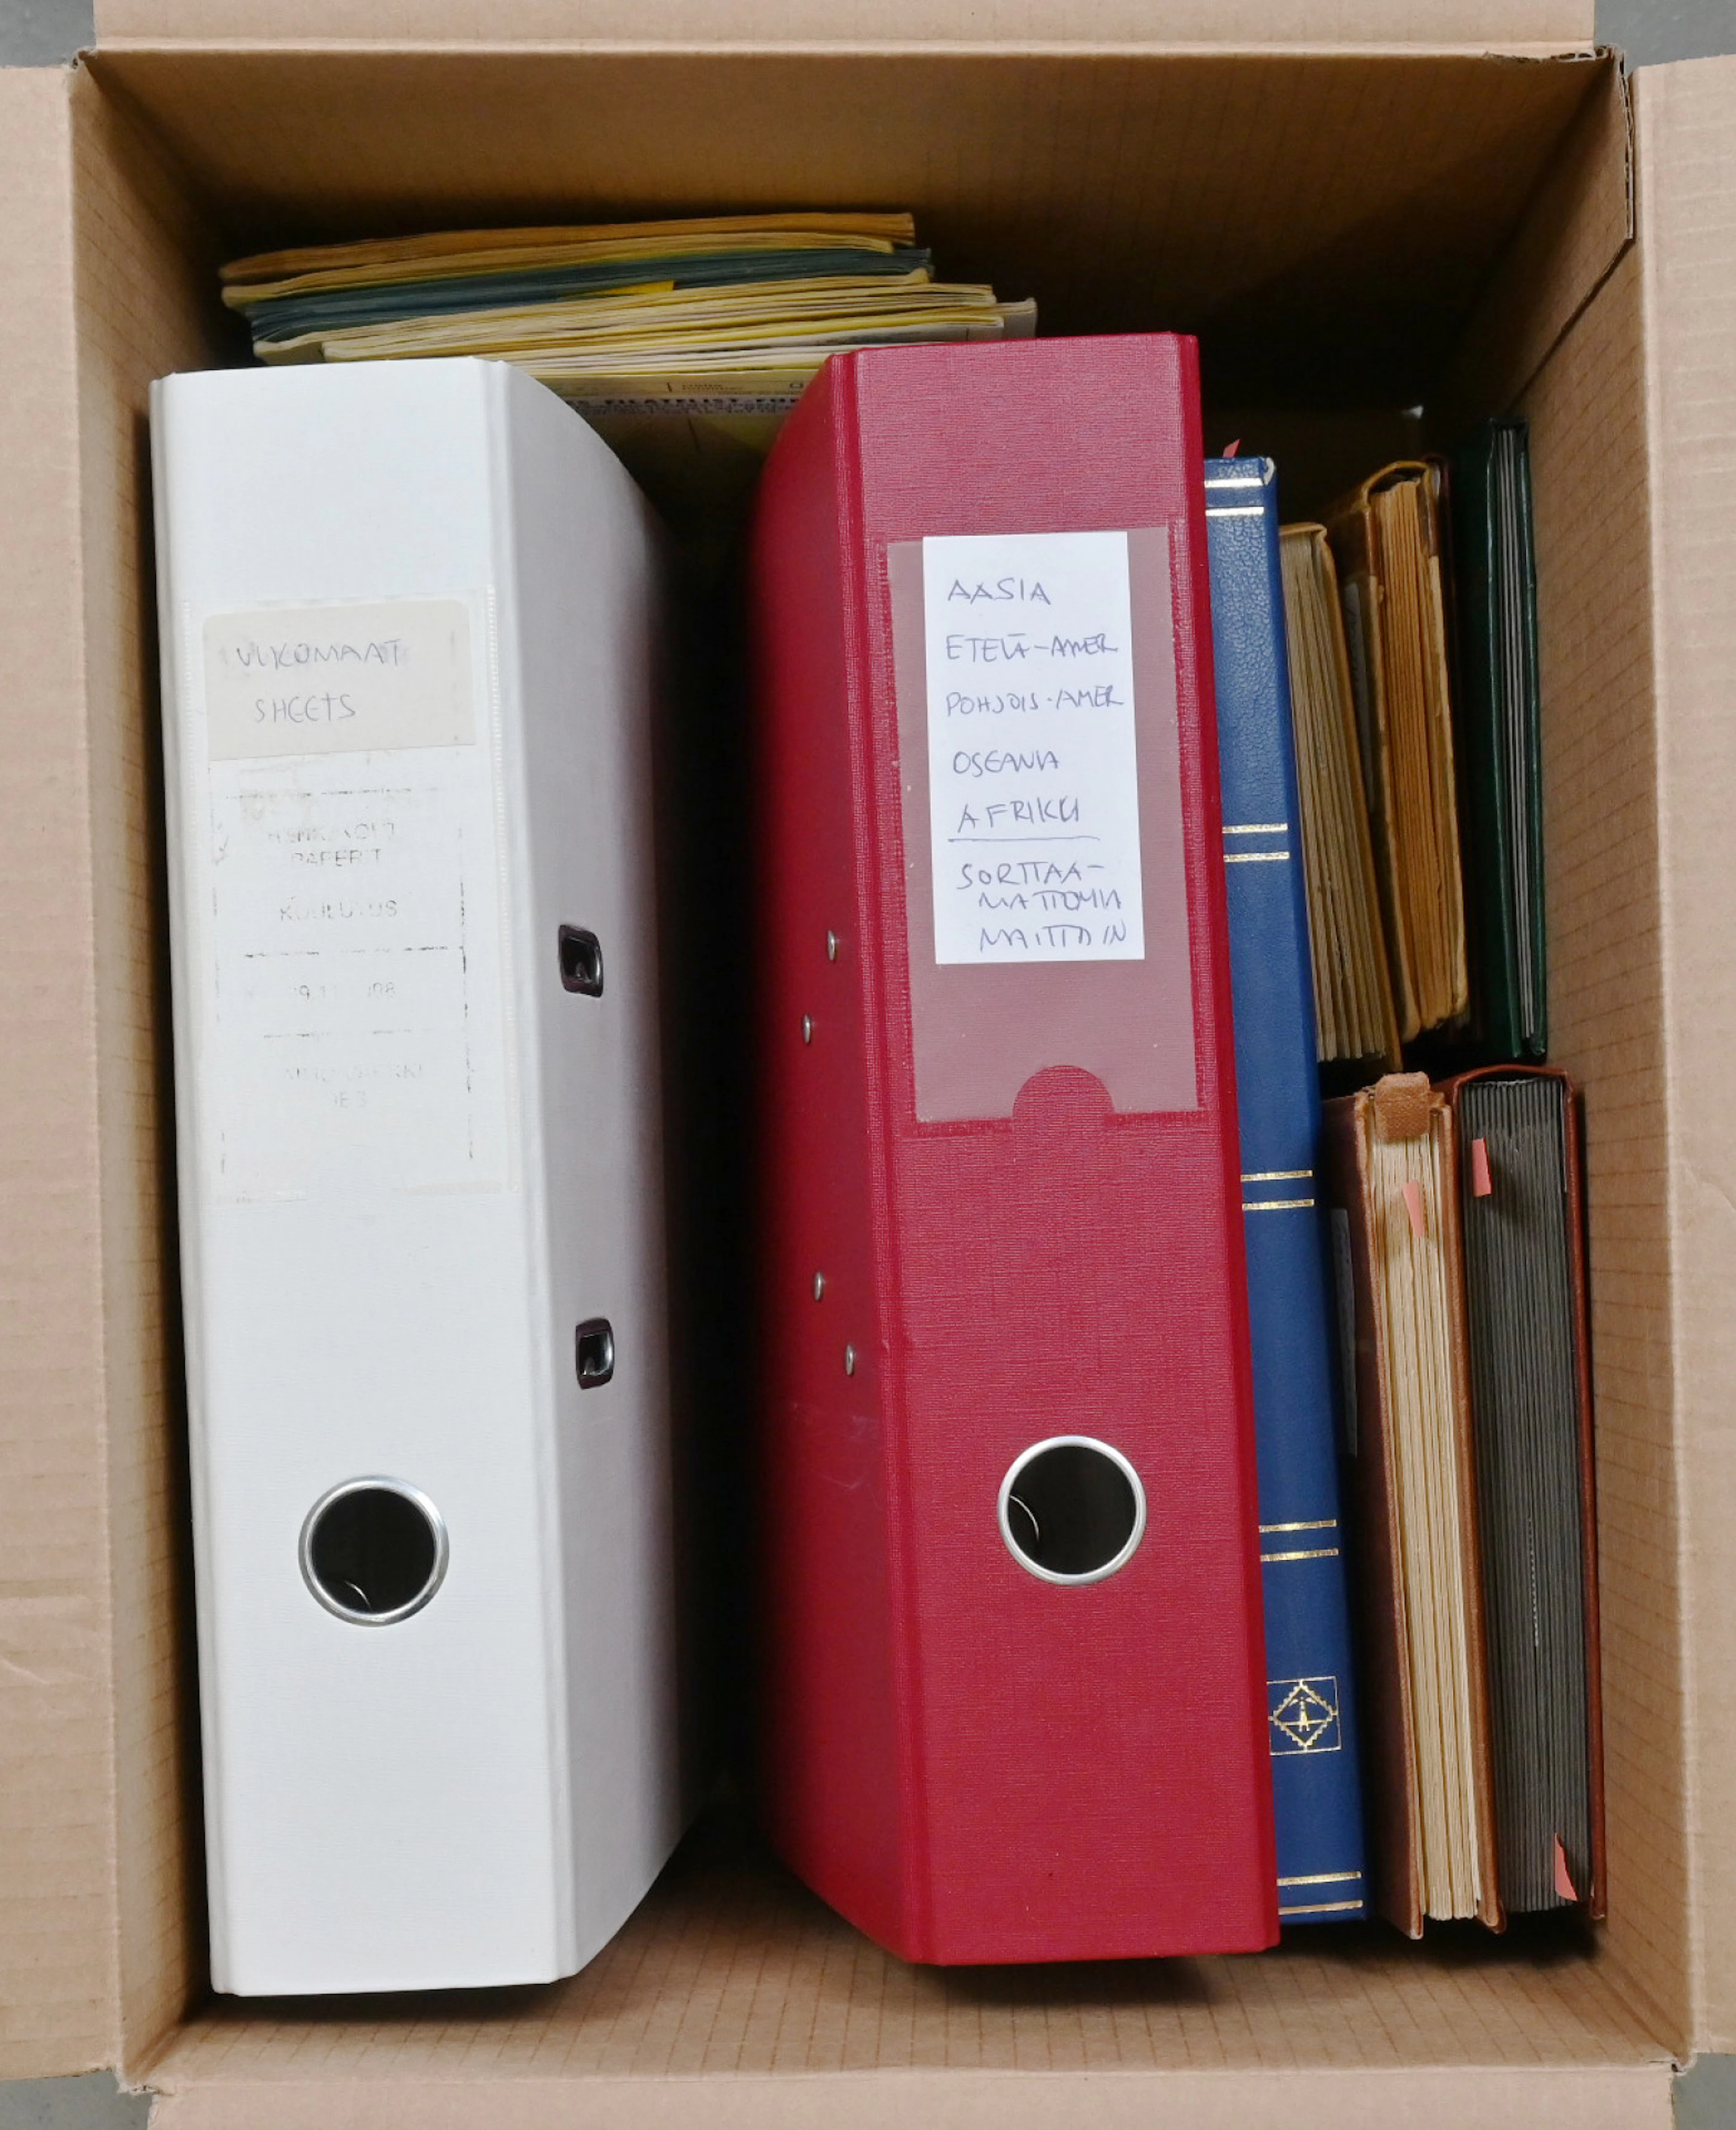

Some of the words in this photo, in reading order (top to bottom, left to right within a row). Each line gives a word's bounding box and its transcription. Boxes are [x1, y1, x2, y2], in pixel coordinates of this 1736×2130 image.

[947, 576, 1052, 606] AASIA
[255, 691, 356, 723] SHEETS
[952, 749, 1060, 778] OSEANIA
[978, 888, 1122, 912] MATTOMIA
